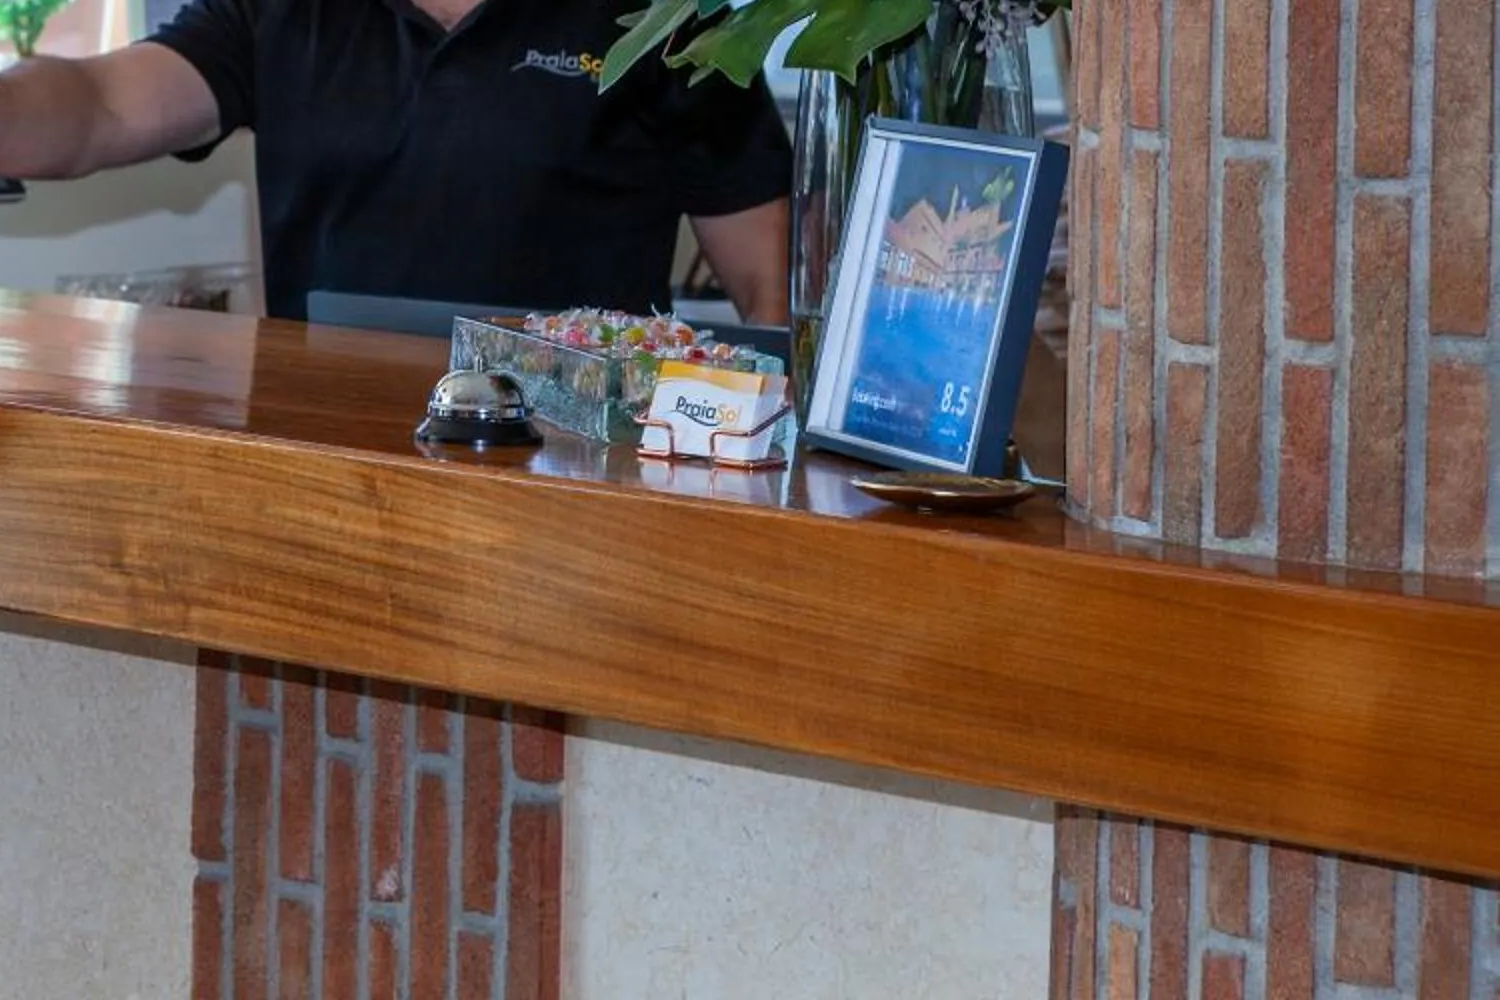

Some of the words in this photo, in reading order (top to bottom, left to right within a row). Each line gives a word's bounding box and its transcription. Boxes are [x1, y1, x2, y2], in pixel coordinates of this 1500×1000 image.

[525, 48, 604, 73] PraiaSo
[675, 395, 743, 424] PraiaSol
[941, 381, 971, 417] 8.5
